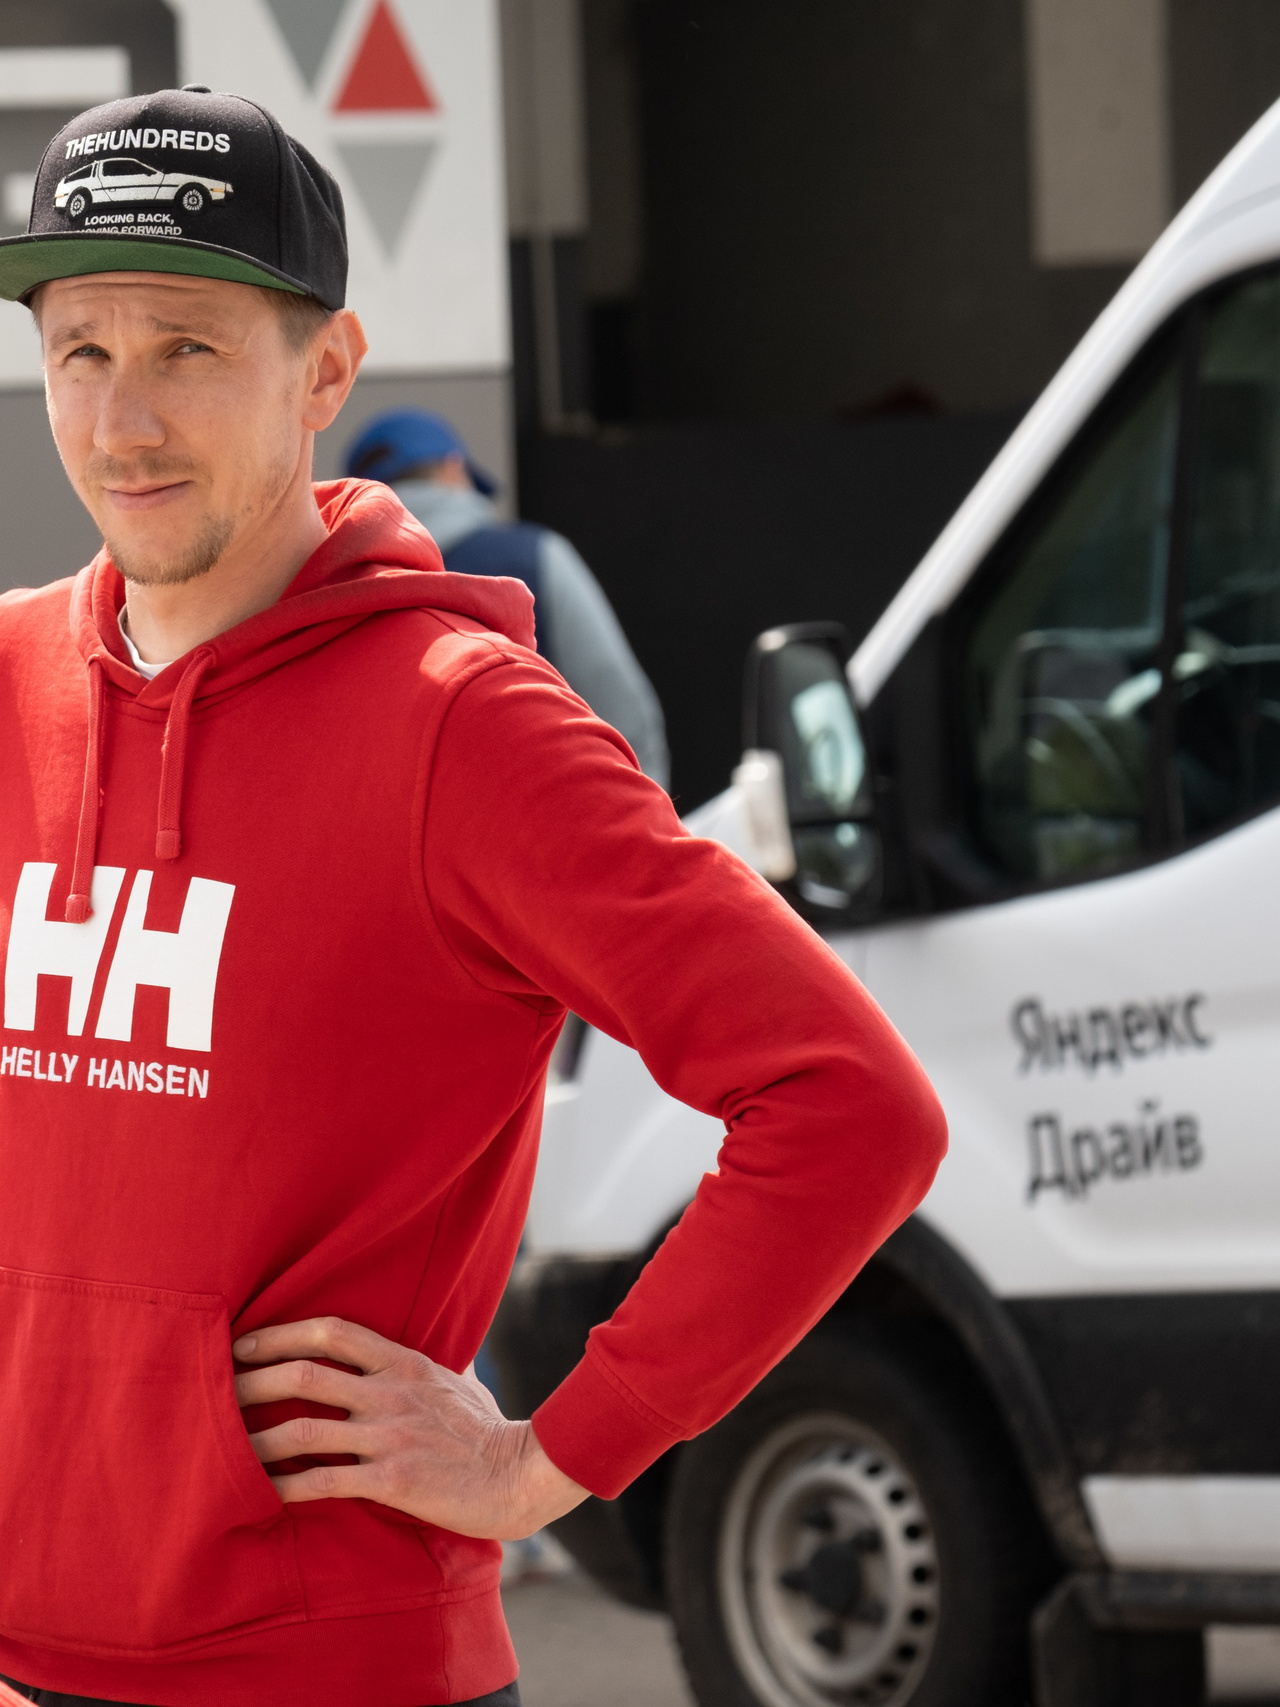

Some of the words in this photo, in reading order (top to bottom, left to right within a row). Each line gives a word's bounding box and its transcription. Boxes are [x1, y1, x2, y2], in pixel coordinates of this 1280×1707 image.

[84, 214, 135, 226] LOOKING
[137, 213, 175, 225] BACK,
[121, 225, 182, 235] FORWARD
[4, 861, 236, 1052] HH
[1009, 993, 1211, 1076] Яндекс
[0, 1046, 79, 1083] HELLY
[87, 1057, 210, 1099] HANSEN
[1025, 1099, 1205, 1205] Драйв
